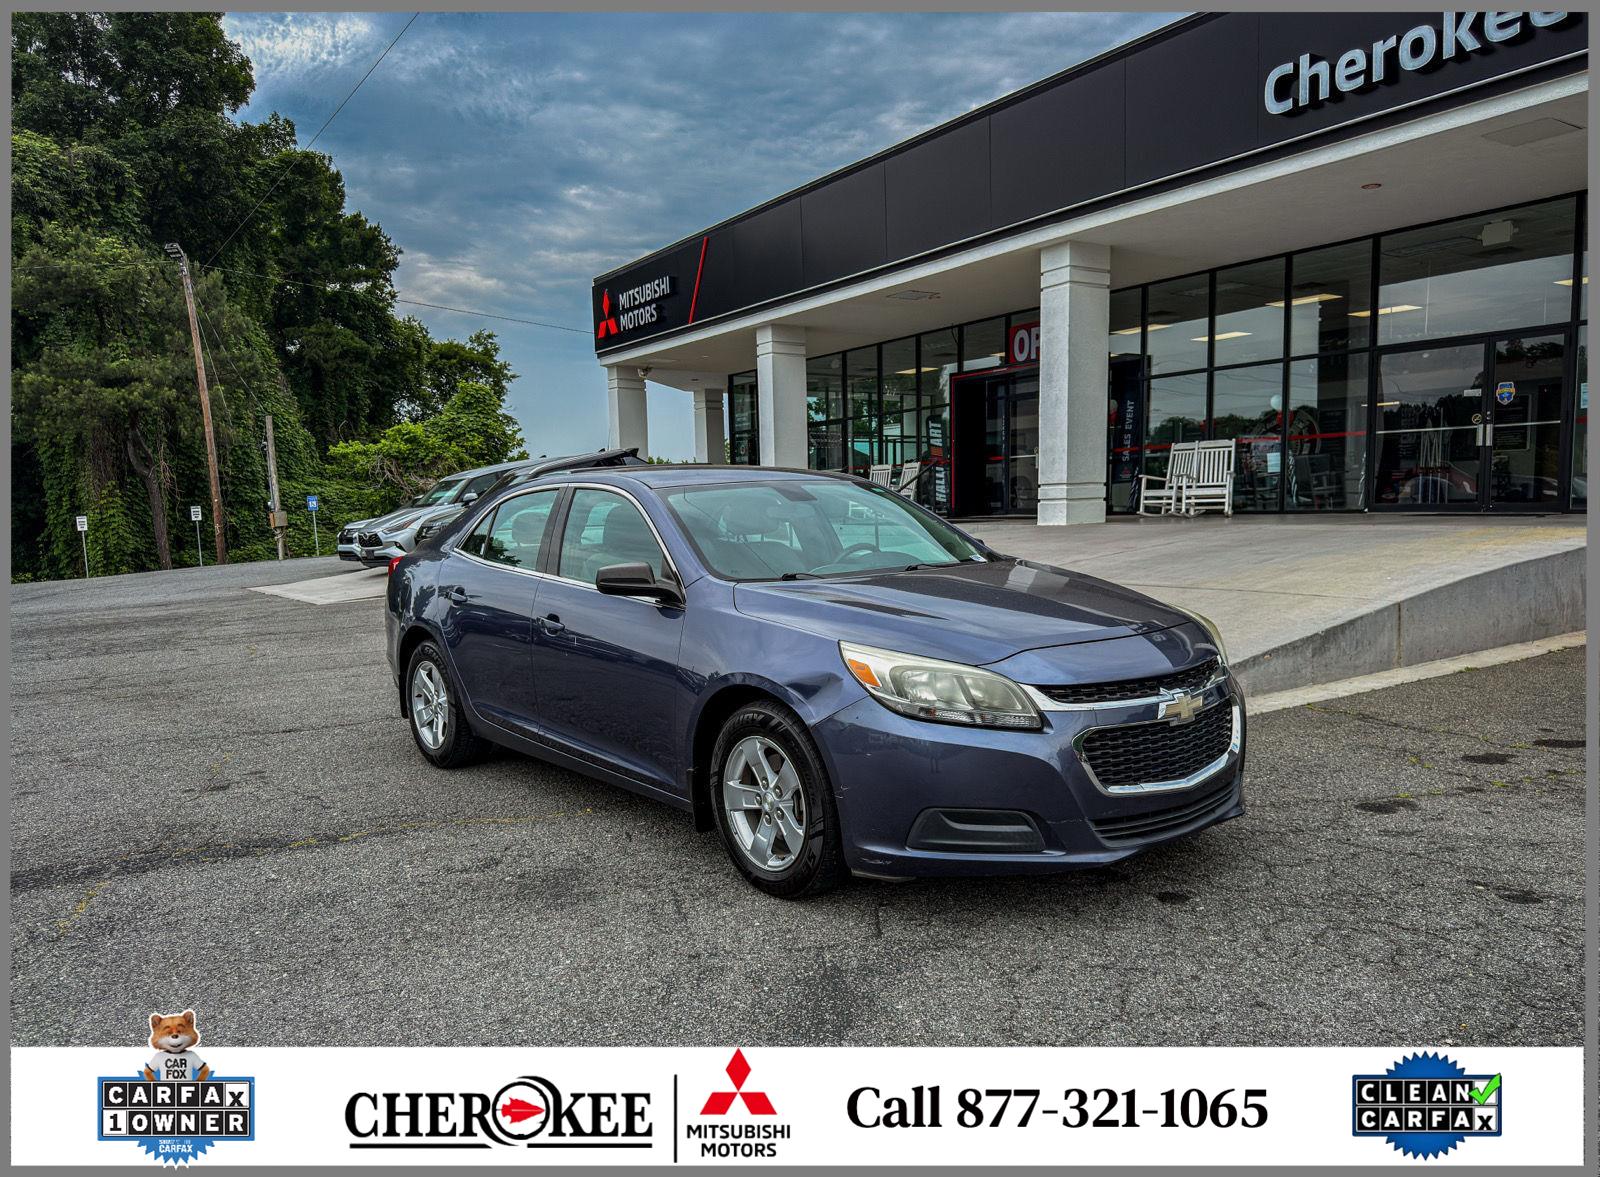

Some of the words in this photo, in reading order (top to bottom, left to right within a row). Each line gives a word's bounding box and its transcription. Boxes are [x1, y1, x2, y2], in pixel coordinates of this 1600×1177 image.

[619, 276, 670, 310] MITSUBISHI
[620, 303, 657, 332] MOTORS
[1125, 400, 1135, 430] EVENT
